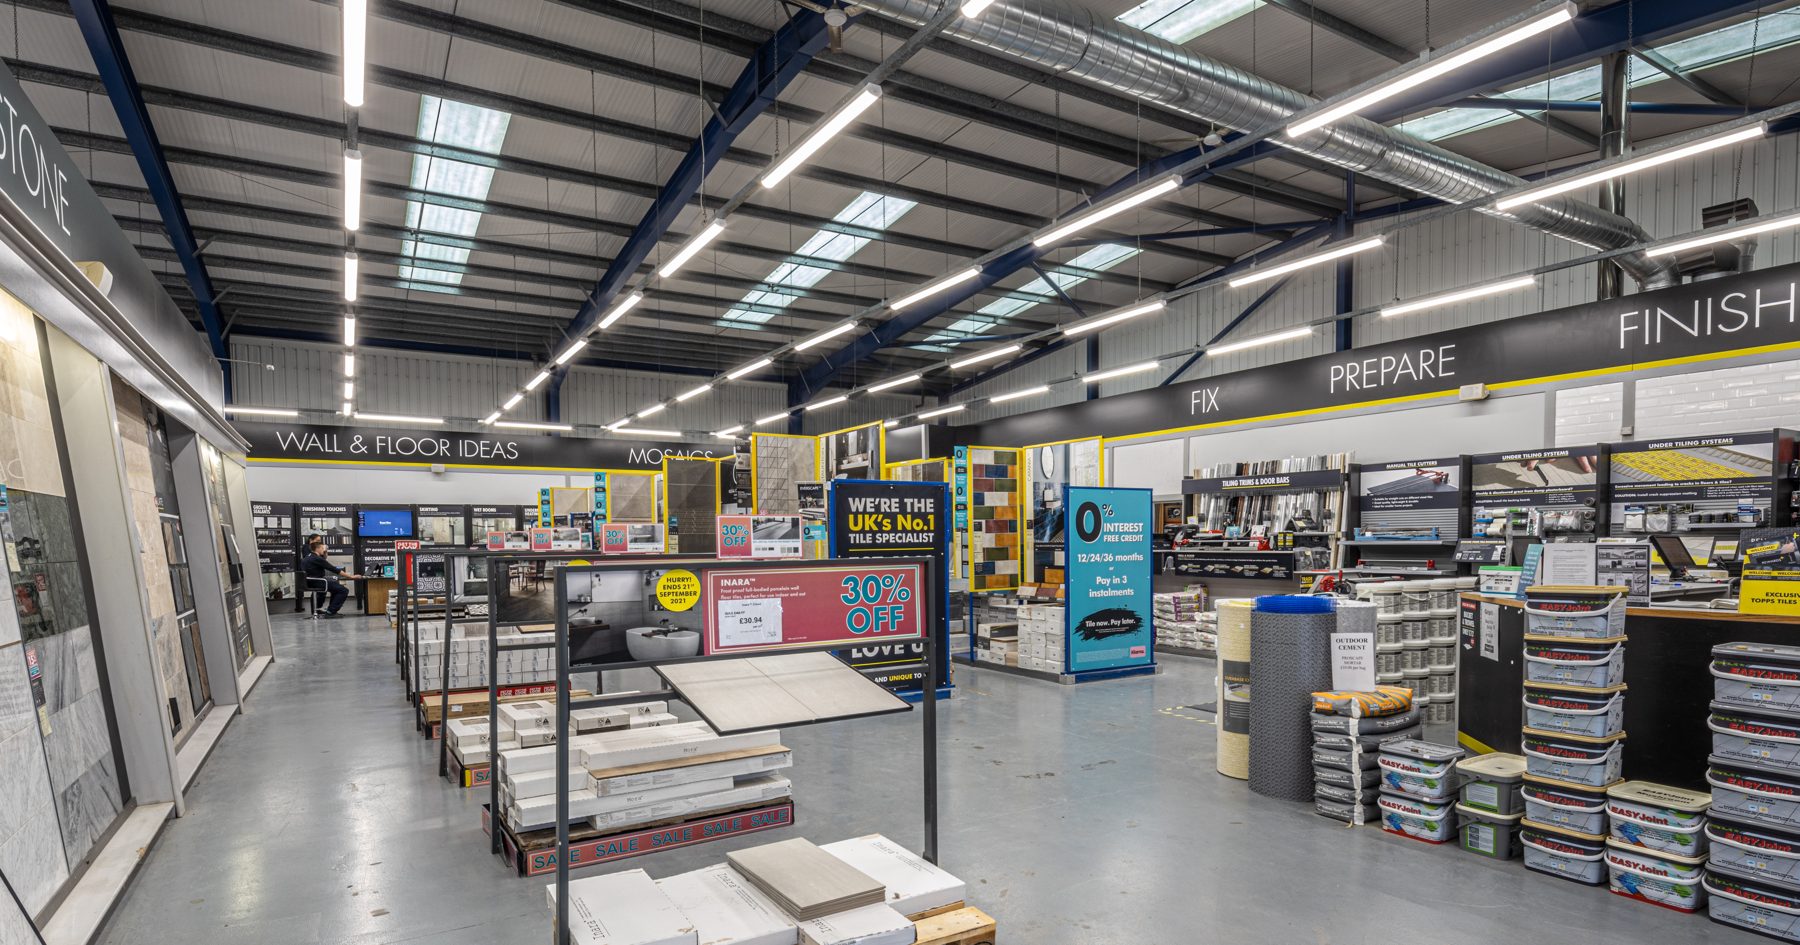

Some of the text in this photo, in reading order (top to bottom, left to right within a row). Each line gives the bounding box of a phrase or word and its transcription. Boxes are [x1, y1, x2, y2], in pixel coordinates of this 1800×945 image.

[1620, 282, 1796, 350] FINISH
[1330, 344, 1456, 394] PREPARE
[1190, 386, 1220, 415] FIX
[276, 431, 519, 460] WALL & FLOOR IDEAS
[1675, 439, 1700, 447] TILING
[1701, 437, 1734, 445] SYSTEMS
[628, 447, 713, 465] MOSAICS
[1260, 477, 1276, 485] DOOR
[1276, 476, 1290, 484] BARS
[848, 497, 935, 513] WE'RE THE
[848, 514, 935, 532] UK's No.1
[1103, 523, 1144, 533] INTEREST
[606, 530, 625, 538] 30%
[722, 525, 749, 536] 30%
[607, 537, 624, 545] OFF
[723, 536, 747, 547] OFF
[848, 532, 935, 544] TILE SPECIALIST
[1103, 534, 1144, 543] FREE CREDIT
[1077, 552, 1144, 563] 12/24/36 months
[1096, 575, 1128, 587] Pay in 3
[660, 590, 697, 598] SEPTEMBER
[841, 574, 911, 605] 30%
[1088, 588, 1135, 598] instalments
[1539, 603, 1592, 612] EASYJoint
[739, 616, 763, 625] £30.94
[846, 605, 905, 635] OFF
[1085, 620, 1096, 628] Tile
[1110, 618, 1121, 627] Pay
[1121, 617, 1136, 625] later.
[851, 643, 905, 659] LOVE
[1538, 651, 1590, 661] EASYJoint
[889, 673, 913, 682] UNIQUE
[1730, 667, 1798, 681] EASYJoint
[1537, 698, 1589, 710] EASYJoint
[1728, 721, 1797, 738] EASYJoint
[1536, 745, 1588, 760] EASYJoint
[1381, 758, 1422, 773] EASYJoint
[1727, 777, 1793, 796] EASYJoint
[1381, 800, 1422, 815] EASYJoint
[1610, 806, 1669, 826] EASYJoint
[533, 809, 789, 869] SAE SALE SALE SALE SALE
[1724, 831, 1793, 852] EASYJoint
[1610, 855, 1669, 877] EASYJoint
[1724, 886, 1793, 908] EASYJoint
